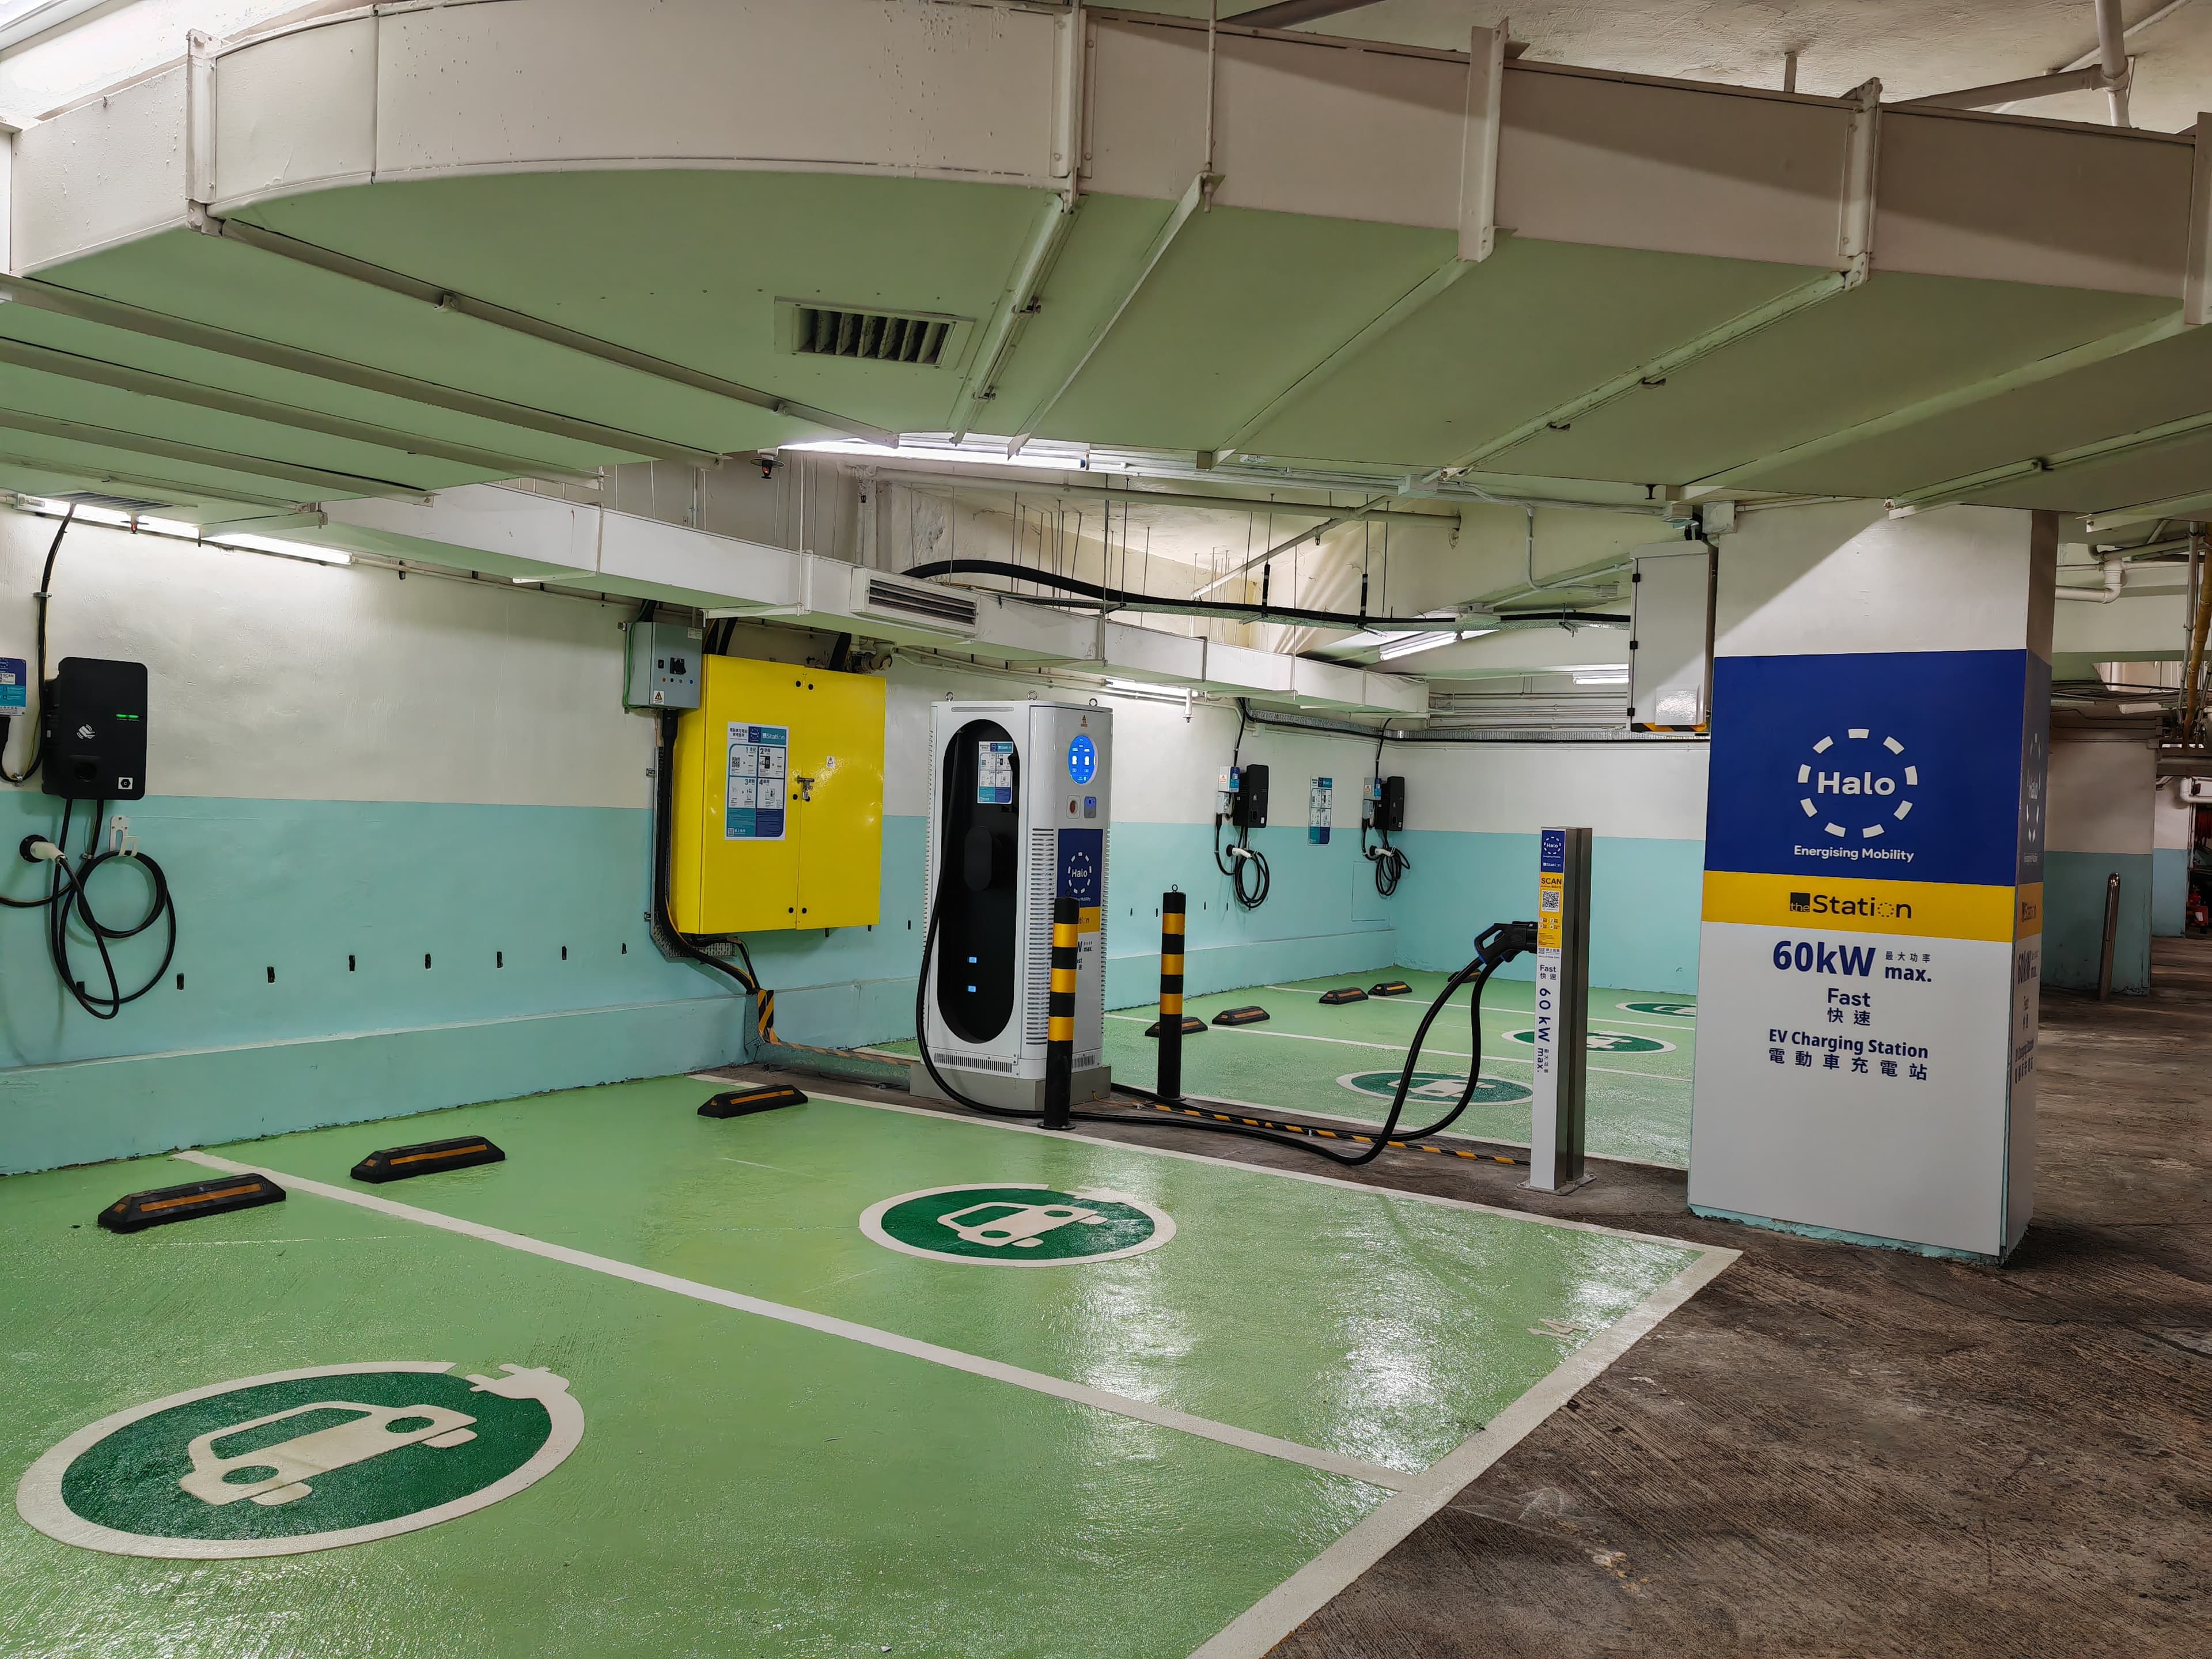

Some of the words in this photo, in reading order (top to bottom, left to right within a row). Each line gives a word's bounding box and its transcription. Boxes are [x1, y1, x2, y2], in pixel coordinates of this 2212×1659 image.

[1817, 772, 1895, 796] Halo
[1794, 845, 1858, 861] Energising
[1862, 849, 1914, 863] Mobility
[1071, 868, 1088, 878] Halo
[1791, 902, 1810, 912] the
[1813, 895, 1912, 919] Station
[1773, 941, 1876, 977] 60kW
[1885, 952, 1931, 963] 最大功率
[1540, 964, 1556, 973] Fast
[1540, 972, 1556, 980] 快速
[1885, 966, 1932, 982] max.
[1828, 988, 1871, 1007] Fast
[1827, 1007, 1871, 1026] 快速
[1769, 1029, 1788, 1043] EV
[1791, 1032, 1863, 1055] Charging
[1868, 1040, 1928, 1059] Station
[1769, 1047, 1927, 1081] 電動車充電站
